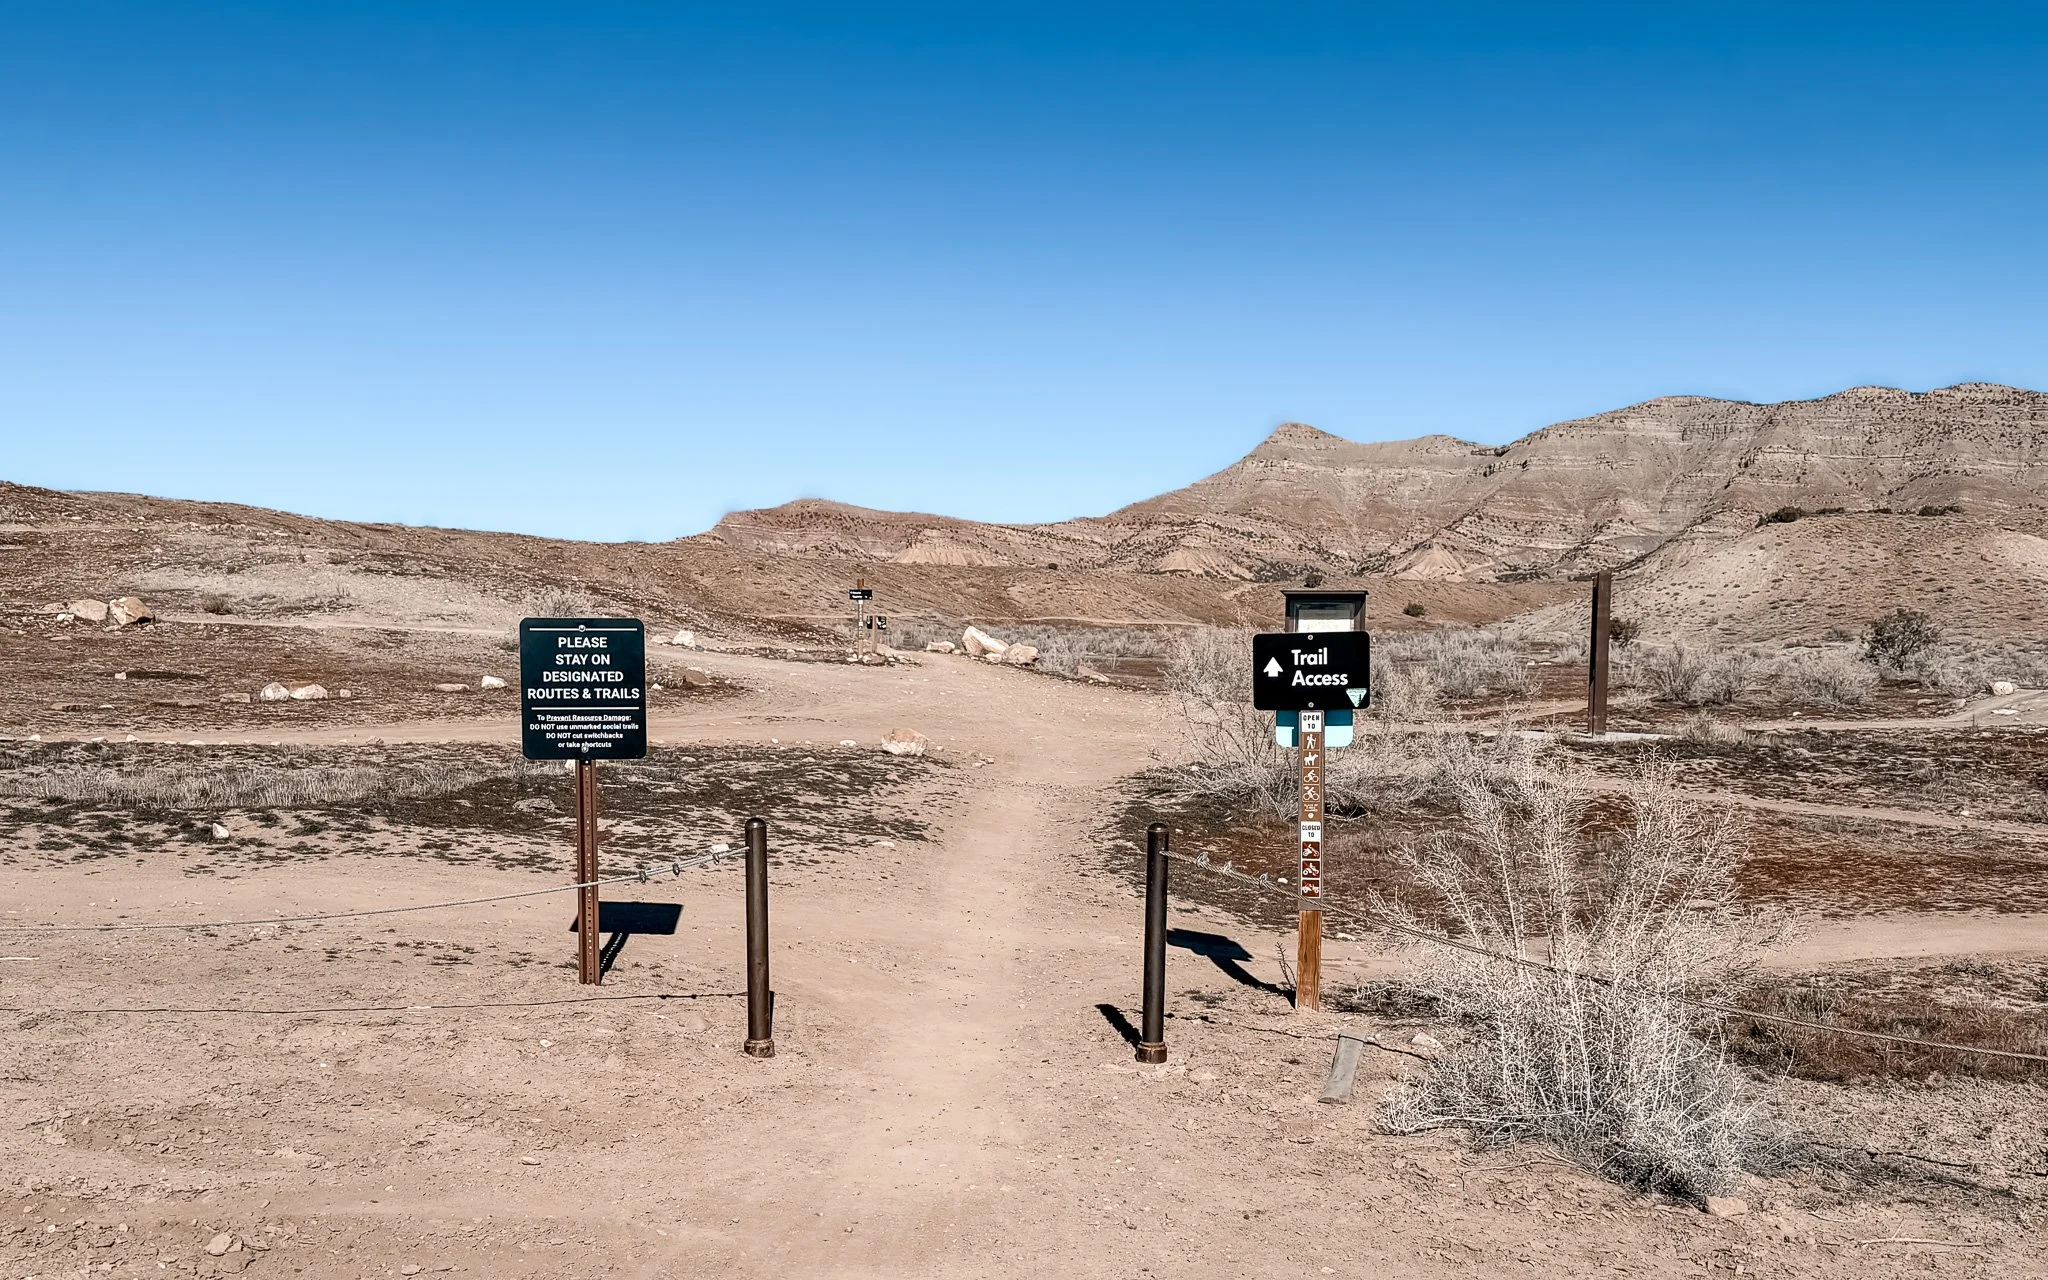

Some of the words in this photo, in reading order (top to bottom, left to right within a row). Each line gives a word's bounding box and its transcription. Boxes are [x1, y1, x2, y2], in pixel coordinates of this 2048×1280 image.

[558, 637, 608, 648] PLEASE
[555, 654, 588, 665] STAY
[591, 654, 610, 665] ON
[1291, 647, 1327, 665] Trail
[543, 671, 624, 682] DESIGNATED
[1291, 670, 1348, 686] Access
[527, 688, 579, 699] ROUTES
[582, 688, 592, 699] &
[594, 688, 640, 699] TRAILS
[546, 714, 571, 722] Prevent
[572, 714, 602, 722] Resource
[603, 714, 632, 722] Damage:
